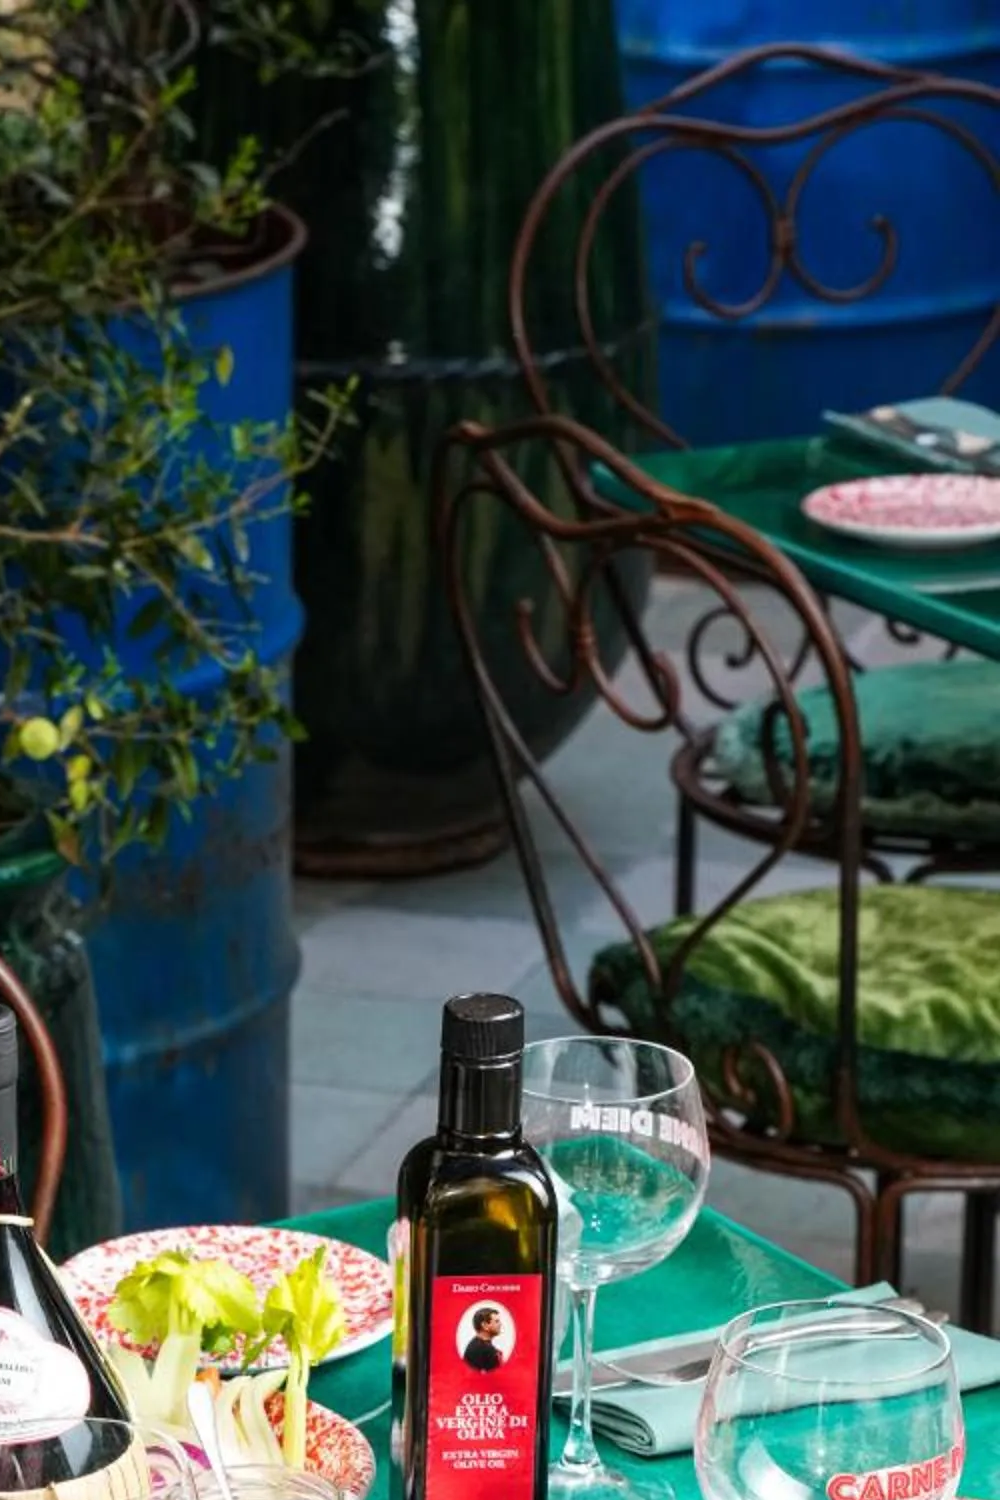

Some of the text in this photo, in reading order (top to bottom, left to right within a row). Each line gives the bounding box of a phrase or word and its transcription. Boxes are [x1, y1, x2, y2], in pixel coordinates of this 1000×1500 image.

[461, 1393, 503, 1405] OLIO
[455, 1405, 508, 1417] EXTRA
[436, 1415, 528, 1429] VERGINE DI
[456, 1428, 505, 1440] OLIVA
[442, 1448, 519, 1460] EXTRA VIRGIN
[453, 1459, 505, 1469] OLIVE OIL
